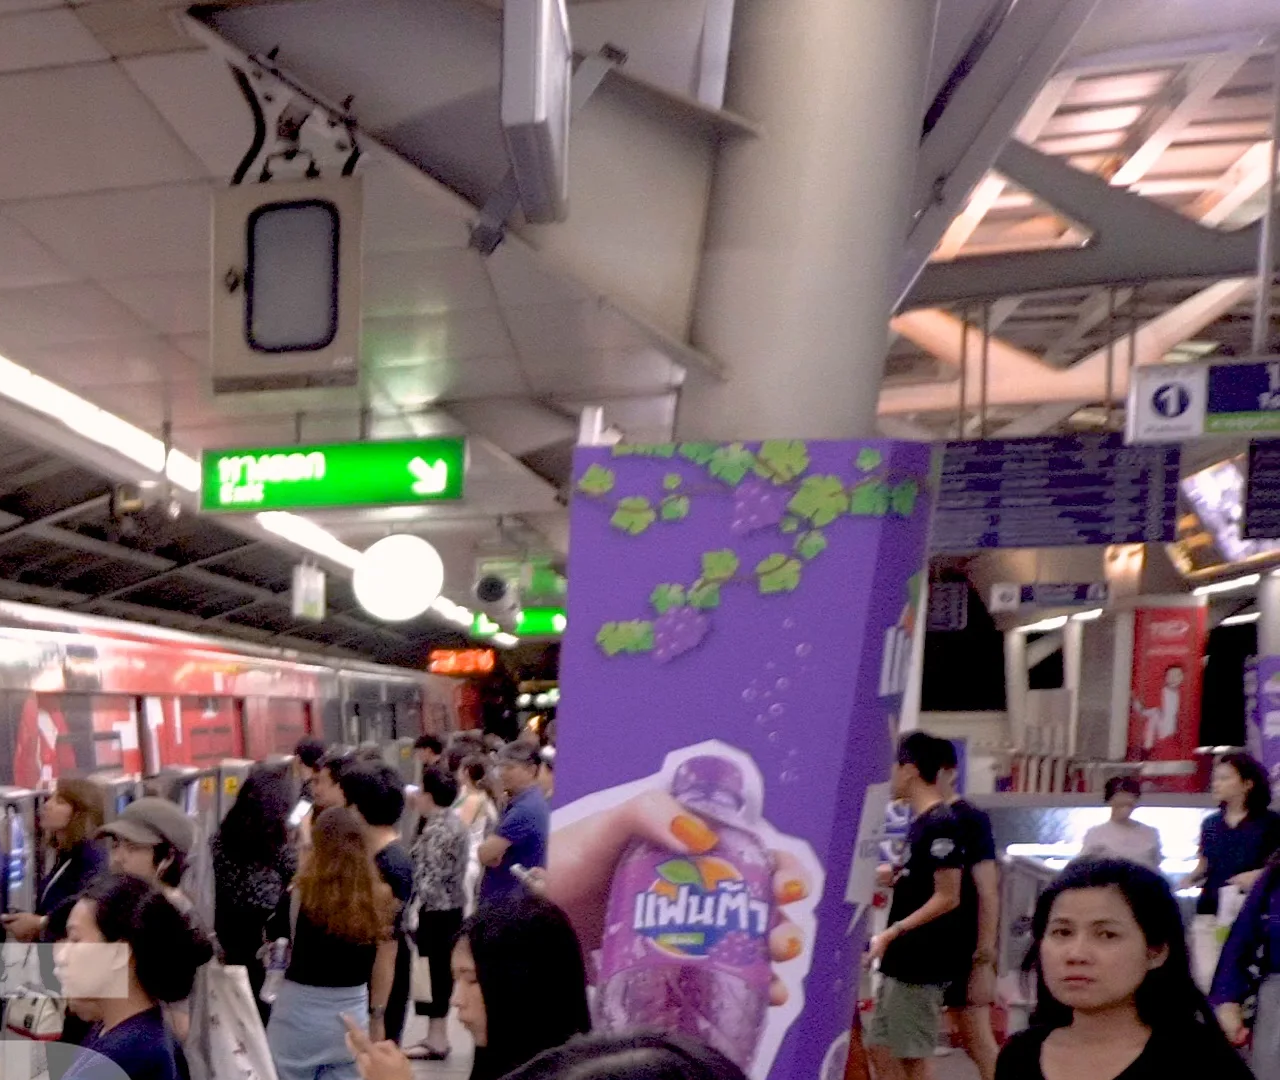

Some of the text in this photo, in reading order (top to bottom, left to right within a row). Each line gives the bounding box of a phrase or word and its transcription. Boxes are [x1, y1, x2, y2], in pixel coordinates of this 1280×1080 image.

[1159, 386, 1181, 417] 1
[217, 452, 326, 485] ทางออก
[633, 881, 770, 936] แฟนต้า
